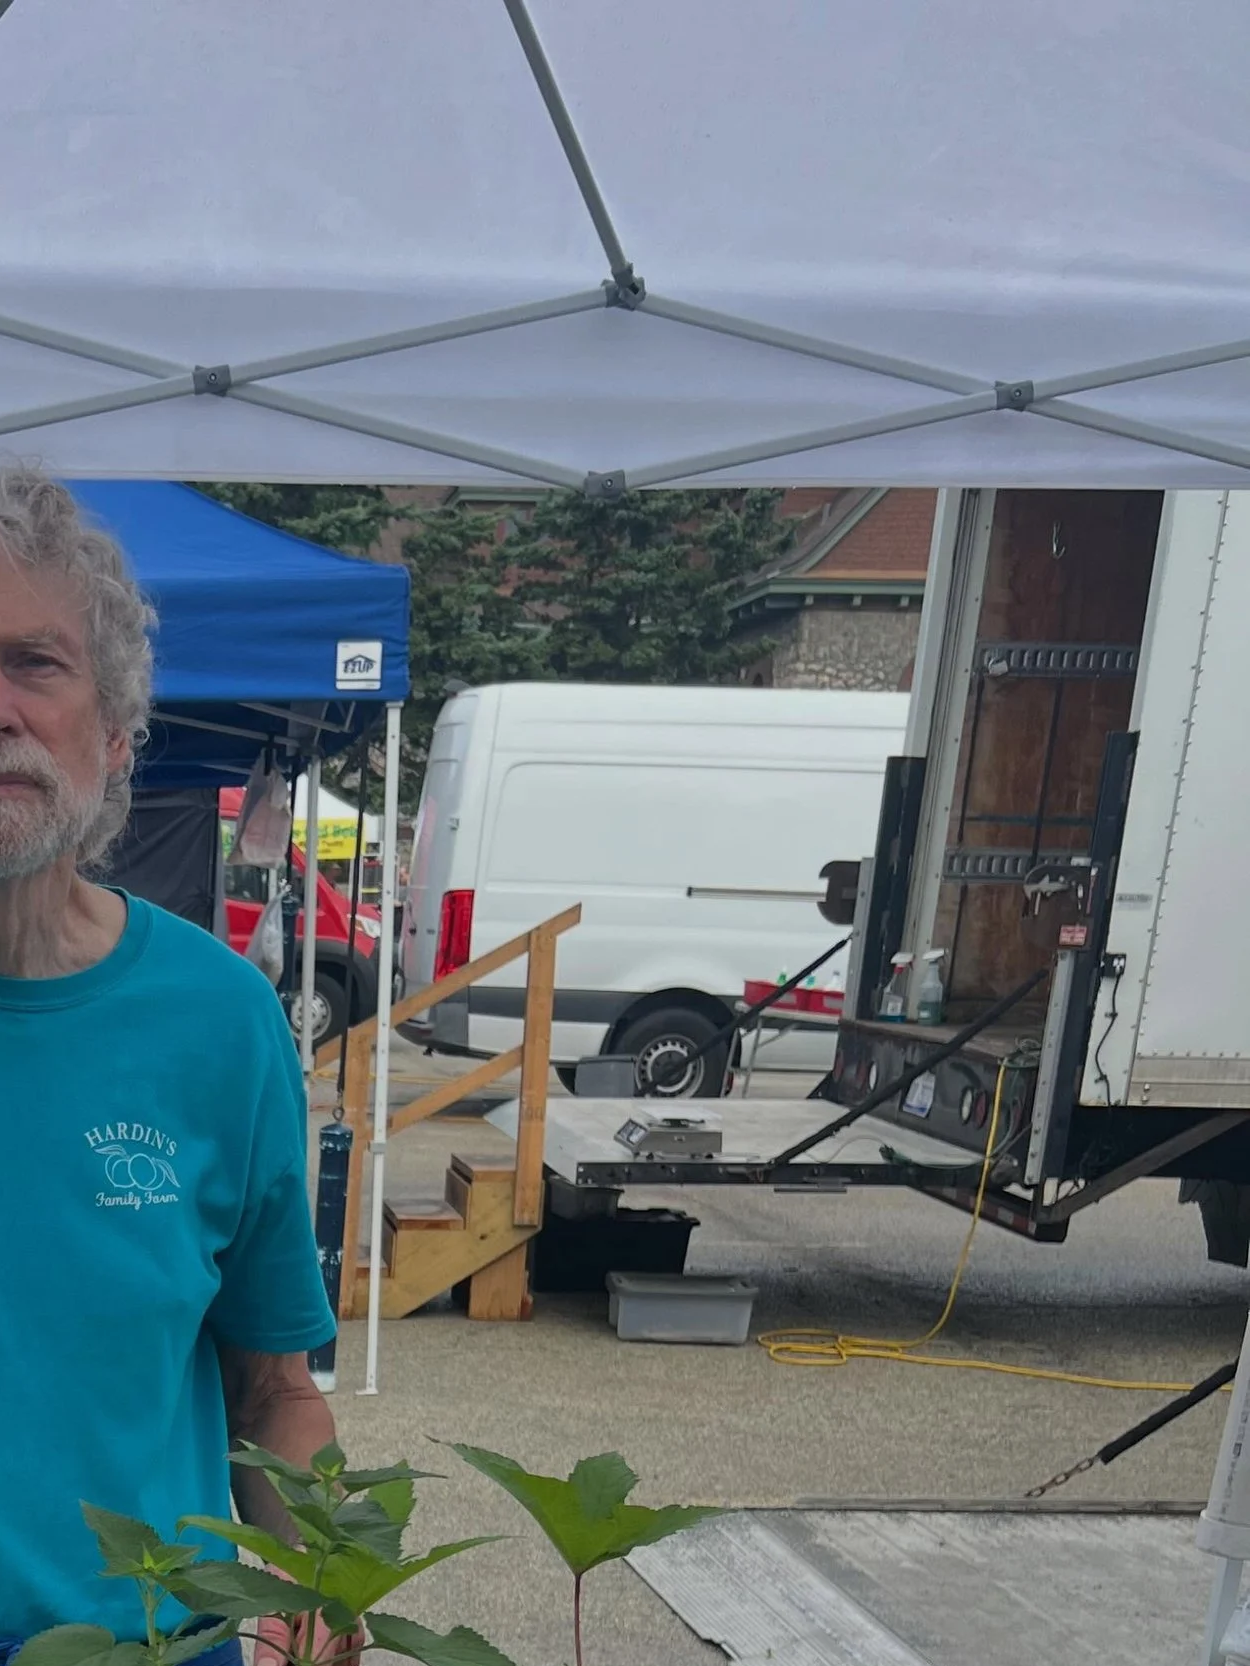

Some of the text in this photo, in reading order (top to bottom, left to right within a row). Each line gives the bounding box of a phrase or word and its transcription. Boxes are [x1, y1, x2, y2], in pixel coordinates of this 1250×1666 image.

[84, 1122, 177, 1156] HARDIN'S
[95, 1192, 179, 1210] Family Farm
